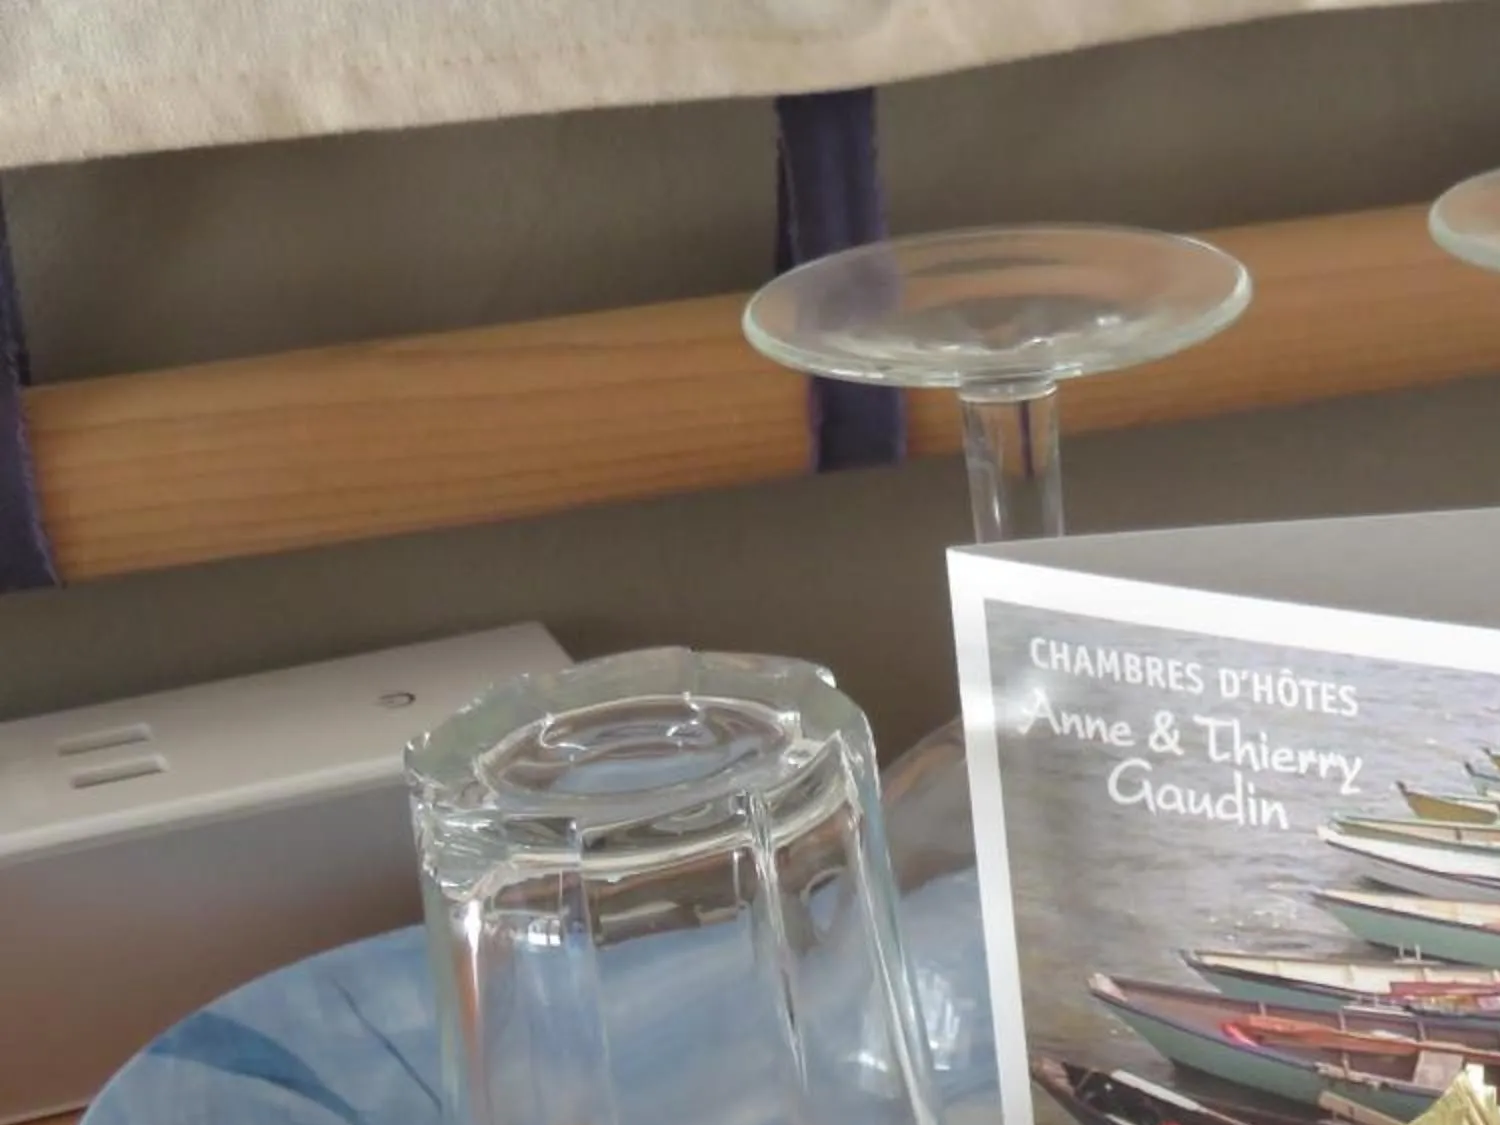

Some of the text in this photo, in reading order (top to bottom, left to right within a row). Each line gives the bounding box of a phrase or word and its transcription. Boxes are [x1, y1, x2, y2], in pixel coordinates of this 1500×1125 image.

[1030, 638, 1360, 718] CHAMBRES D'HÔTES
[1017, 687, 1363, 795] Anne & Thierry
[1107, 758, 1289, 830] Gaudin
